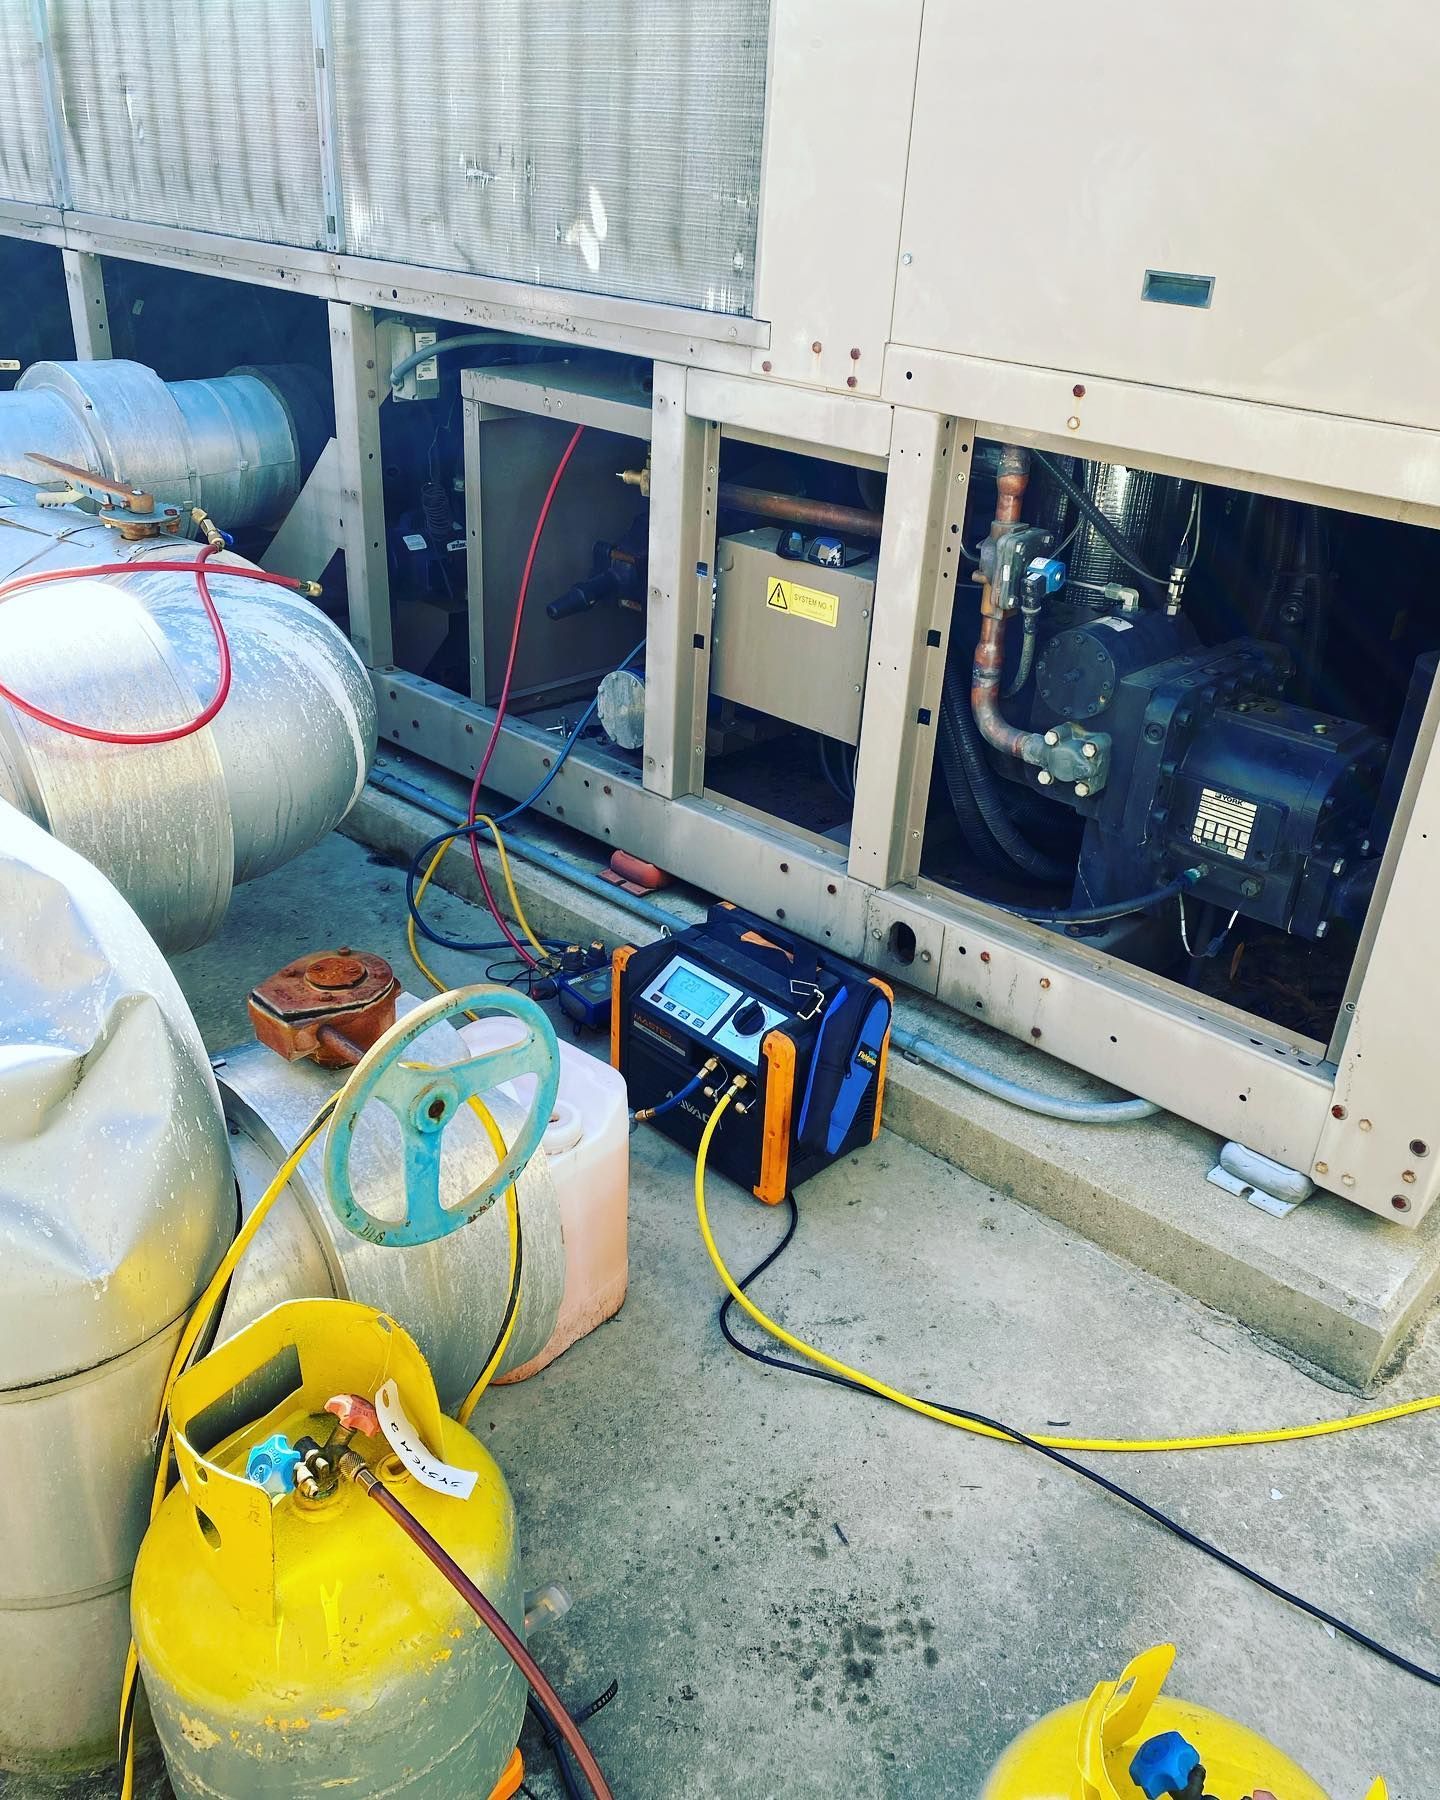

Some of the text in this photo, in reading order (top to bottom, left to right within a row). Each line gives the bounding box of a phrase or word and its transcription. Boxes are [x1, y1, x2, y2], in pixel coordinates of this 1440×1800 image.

[794, 594, 817, 607] SYSTEM
[1222, 794, 1244, 806] YORK
[400, 1440, 464, 1488] SYSTEM
